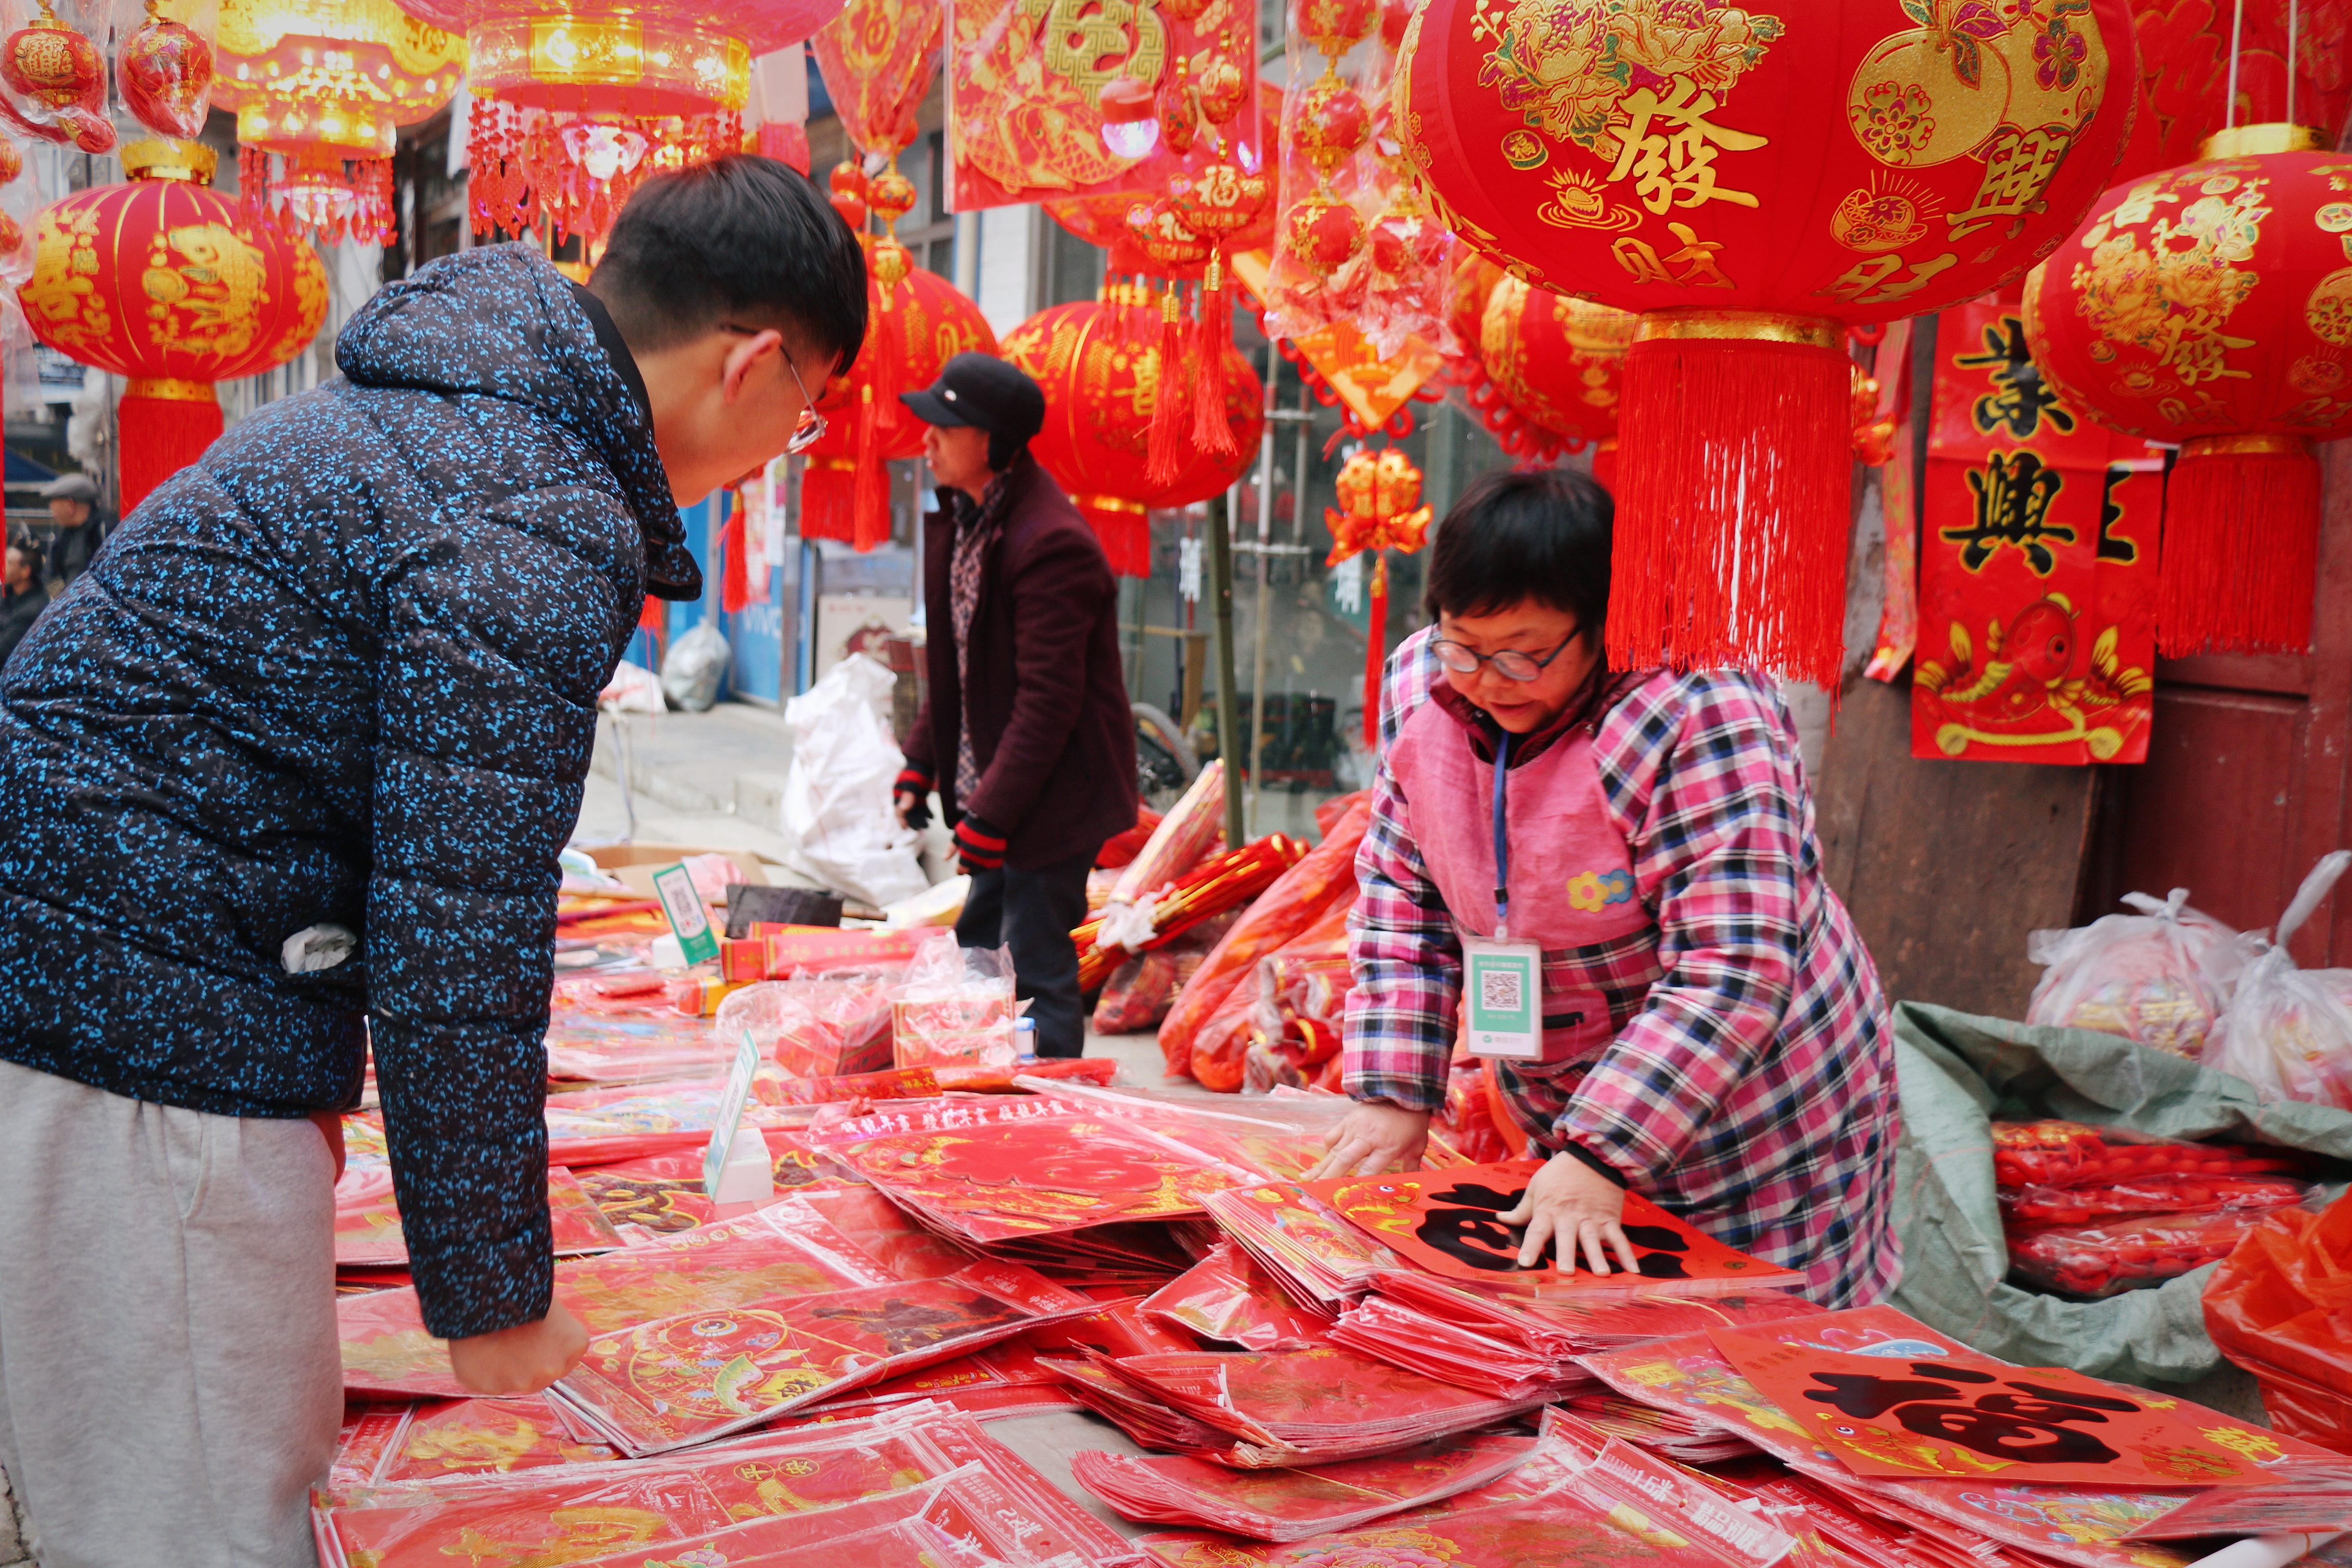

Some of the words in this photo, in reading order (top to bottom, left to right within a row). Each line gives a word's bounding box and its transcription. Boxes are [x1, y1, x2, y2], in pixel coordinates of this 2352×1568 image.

[1509, 133, 1536, 159] 福
[1194, 164, 1240, 208] 福
[1803, 1362, 2141, 1464] 福
[740, 1460, 814, 1480] 平安
[995, 1506, 1044, 1538] 2.2米
[1631, 1469, 1674, 1502] 1.6米
[1689, 1501, 1765, 1553] 精品对联
[1808, 1501, 1863, 1532] 精品对联
